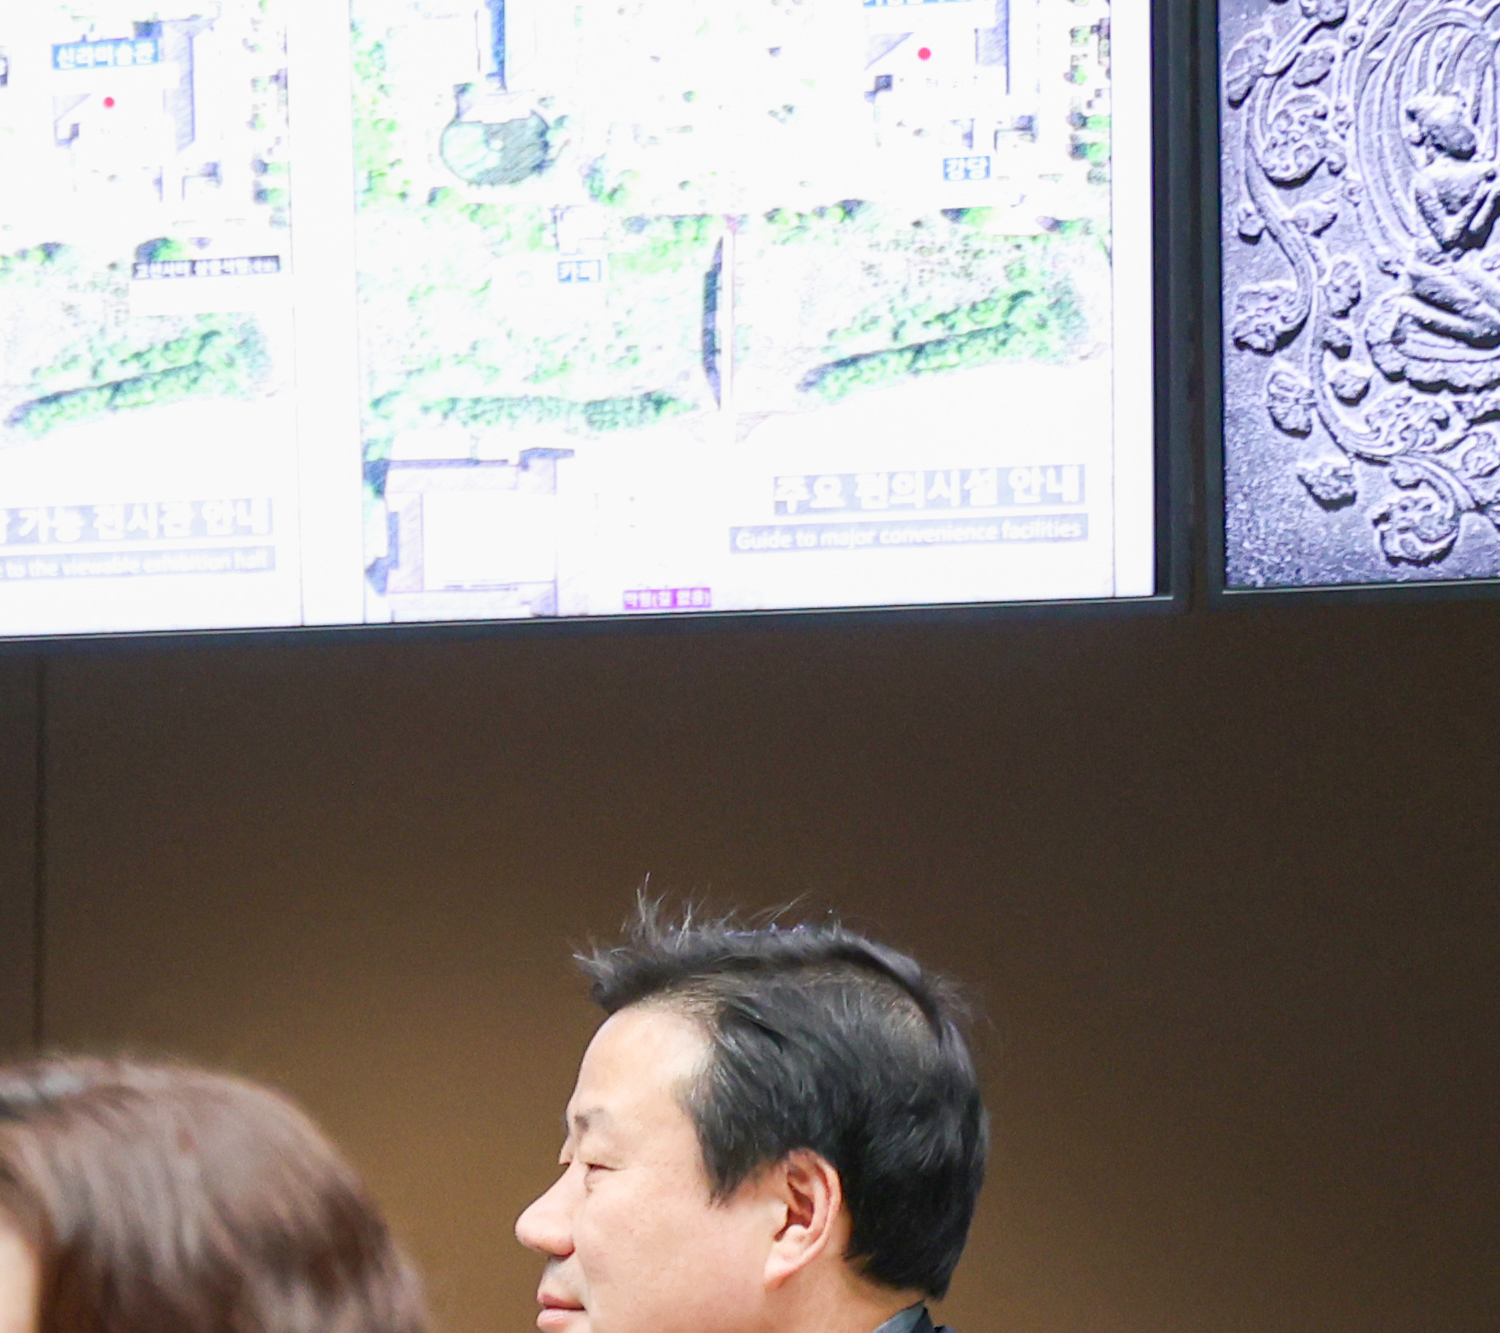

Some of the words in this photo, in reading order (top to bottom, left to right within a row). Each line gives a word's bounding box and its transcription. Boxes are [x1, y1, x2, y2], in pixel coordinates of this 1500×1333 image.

[57, 42, 156, 69] 신라미술관
[946, 157, 988, 177] 강당
[774, 474, 846, 514] 주요
[855, 468, 997, 510] 편의시설
[1008, 464, 1080, 505] 안내
[18, 506, 84, 544] 가능
[93, 501, 196, 540] 전시관
[201, 498, 270, 536] 안내
[735, 527, 793, 550] Guide
[795, 528, 816, 548] to
[819, 525, 876, 551] major
[879, 522, 998, 545] convenience
[1001, 518, 1082, 541] facilities
[6, 561, 26, 579] to
[28, 559, 60, 578] the
